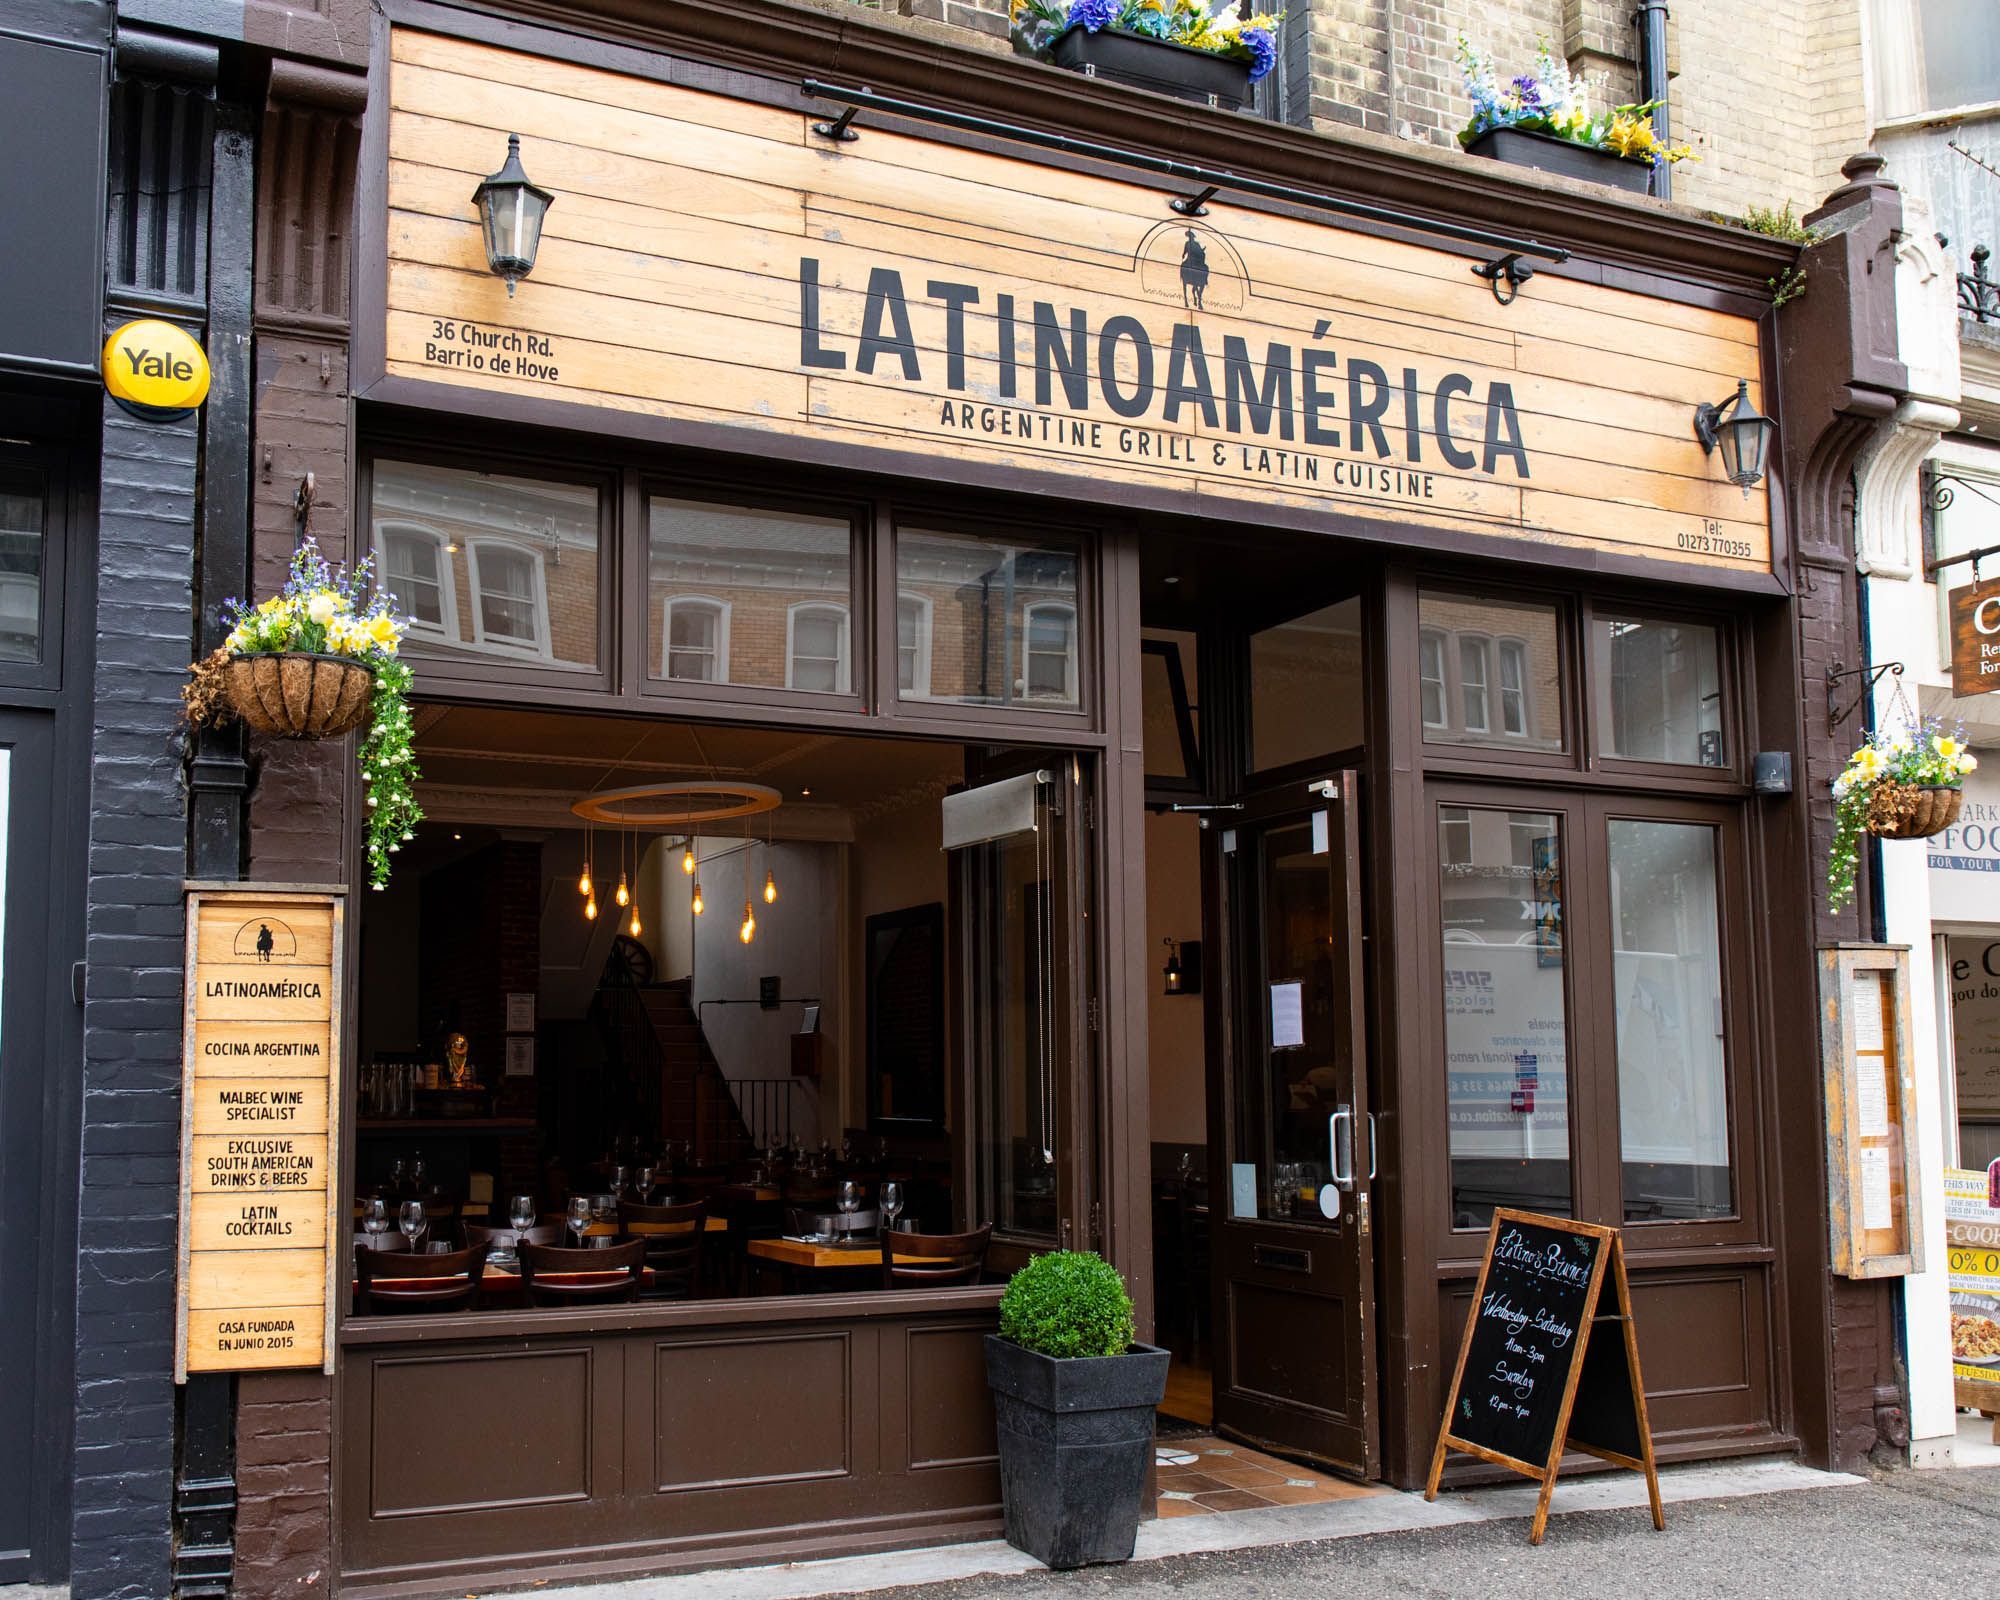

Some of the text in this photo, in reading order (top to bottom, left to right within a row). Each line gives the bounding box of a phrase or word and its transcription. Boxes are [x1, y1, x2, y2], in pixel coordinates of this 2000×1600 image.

[432, 319, 555, 358] 36 Church Rd.
[123, 346, 193, 382] Yale
[425, 342, 559, 381] Barrio de Hove
[799, 256, 1531, 480] LATINOAMÉRICA
[940, 400, 1434, 499] ARGENTINE GRILL & LATIN CUISINE
[1702, 518, 1723, 536] Tel:
[1677, 532, 1752, 558] 01273 770355
[1981, 643, 2000, 658] Re
[1957, 803, 1999, 823] ARK
[1930, 855, 1993, 872] FOR YOUR
[206, 978, 322, 998] LATINOAMÉRICA
[205, 1042, 320, 1057] COCINA ARGENTINA
[219, 1091, 303, 1106] MALBEC WINE
[226, 1107, 296, 1122] SPECIALIST
[228, 1140, 293, 1155] EXCLUSIVE
[207, 1156, 313, 1171] SOUTH AMERICAN
[211, 1171, 308, 1187] DRINKS & BEERS
[241, 1206, 278, 1220] LATIN
[226, 1222, 292, 1237] COCKTAILS
[1538, 1243, 1592, 1284] Brunch
[218, 1320, 295, 1334] CASA FUNDADA
[218, 1336, 293, 1351] EN JUNIO 2015
[1488, 1360, 1535, 1399] Sunday
